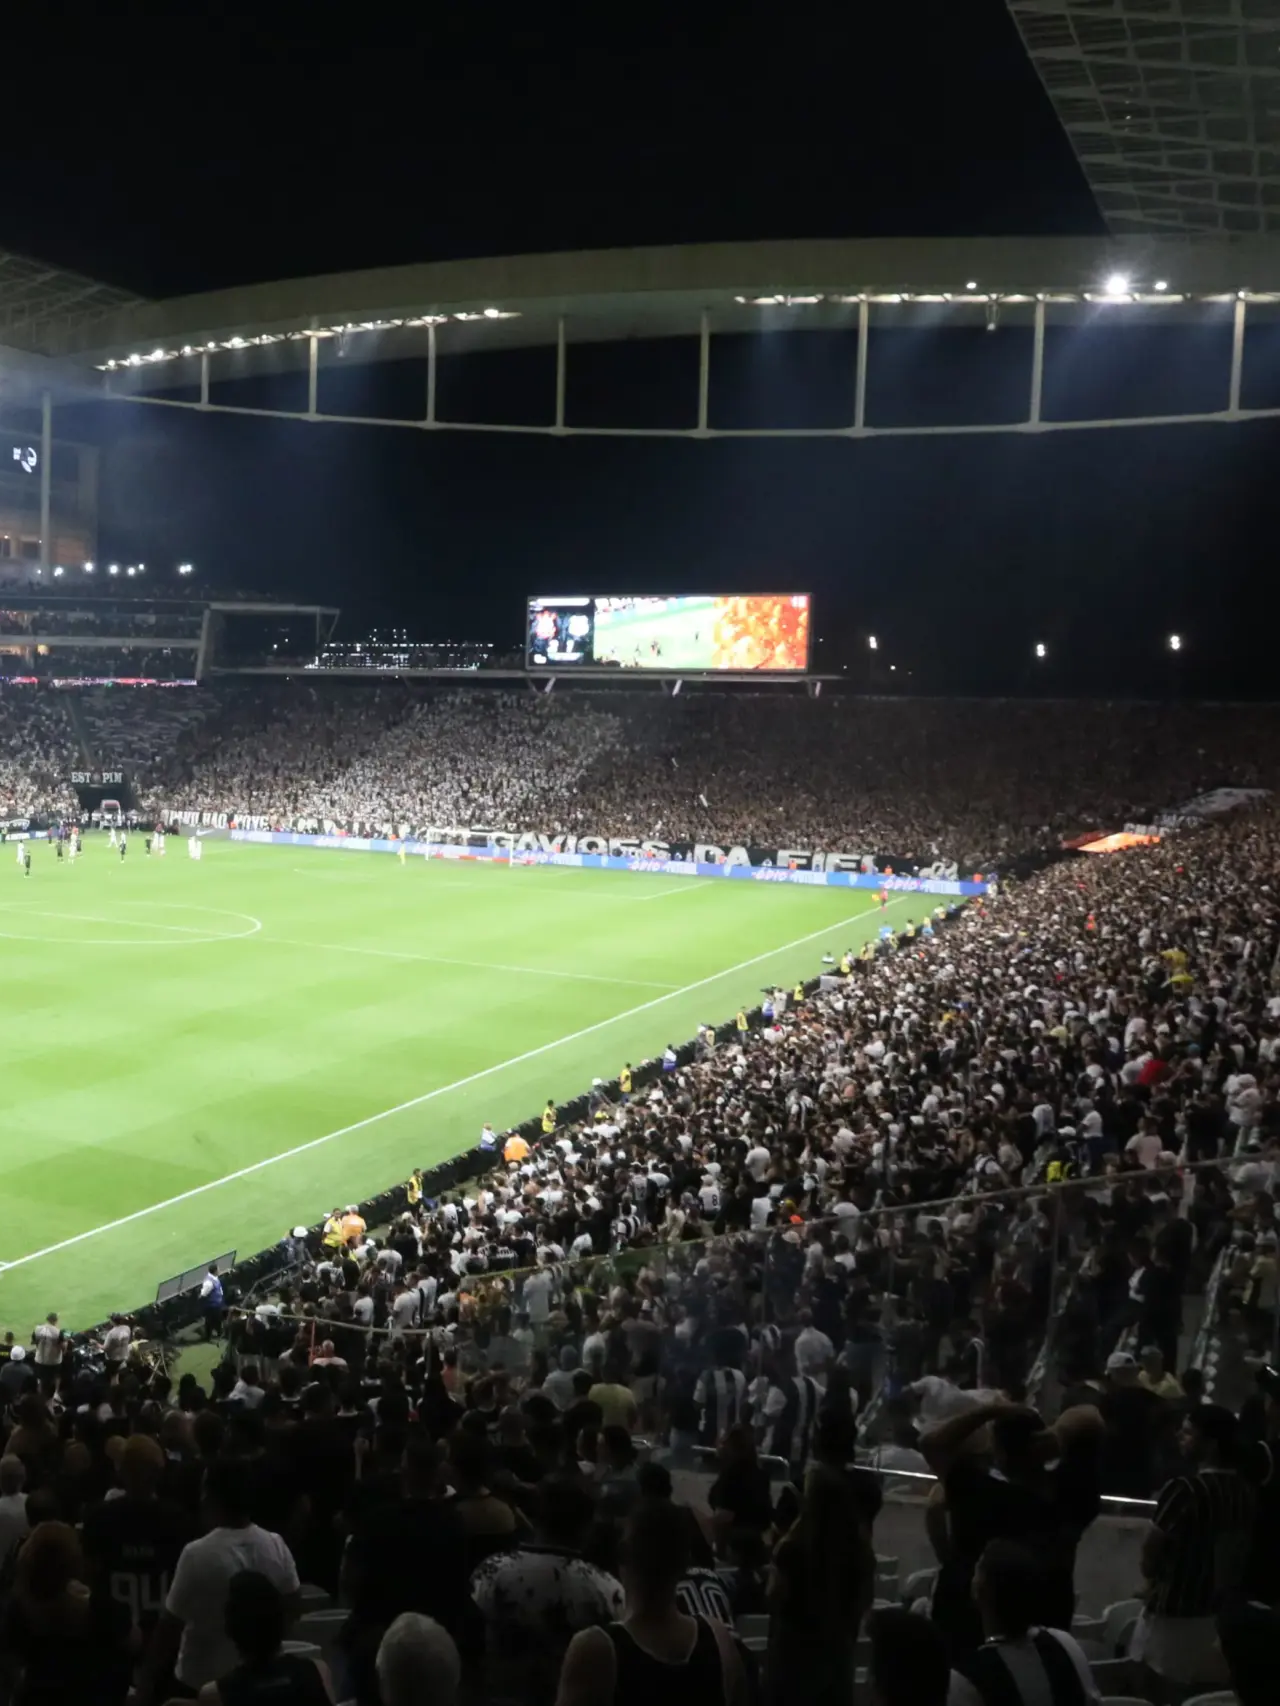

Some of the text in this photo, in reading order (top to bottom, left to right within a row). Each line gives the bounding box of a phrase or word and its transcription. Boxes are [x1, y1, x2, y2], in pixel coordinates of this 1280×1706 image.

[693, 843, 752, 867] DA
[110, 1568, 170, 1628] 94
[675, 1579, 734, 1629] 10
